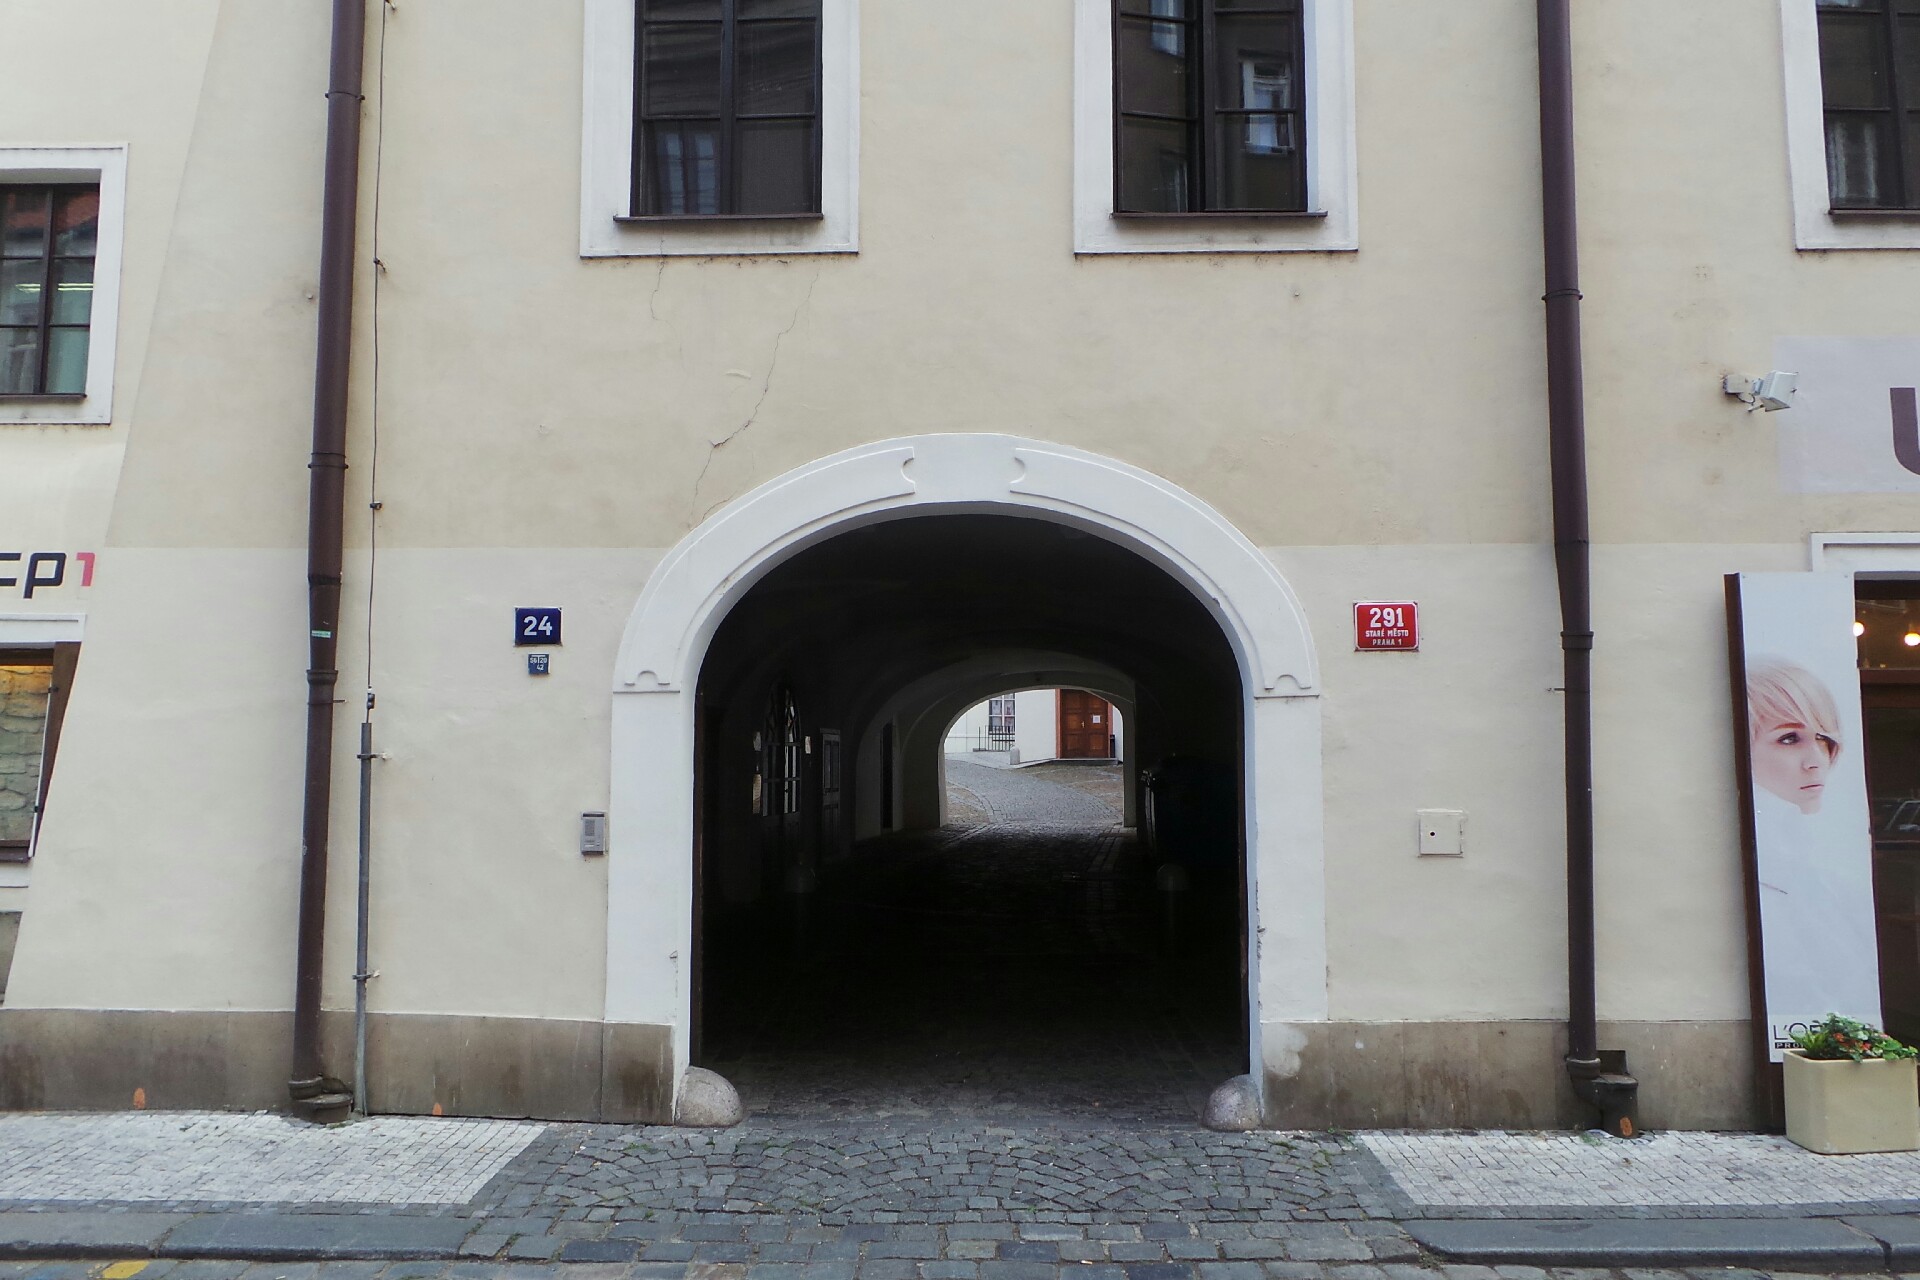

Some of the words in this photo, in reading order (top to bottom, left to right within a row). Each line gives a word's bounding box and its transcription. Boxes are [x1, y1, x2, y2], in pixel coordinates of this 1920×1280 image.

[523, 615, 553, 636] 24
[1370, 607, 1404, 628] 291
[1365, 628, 1385, 638] STARÉ
[1387, 627, 1409, 637] MĚSTO
[1372, 638, 1396, 646] PRAHA
[1398, 638, 1402, 646] 1
